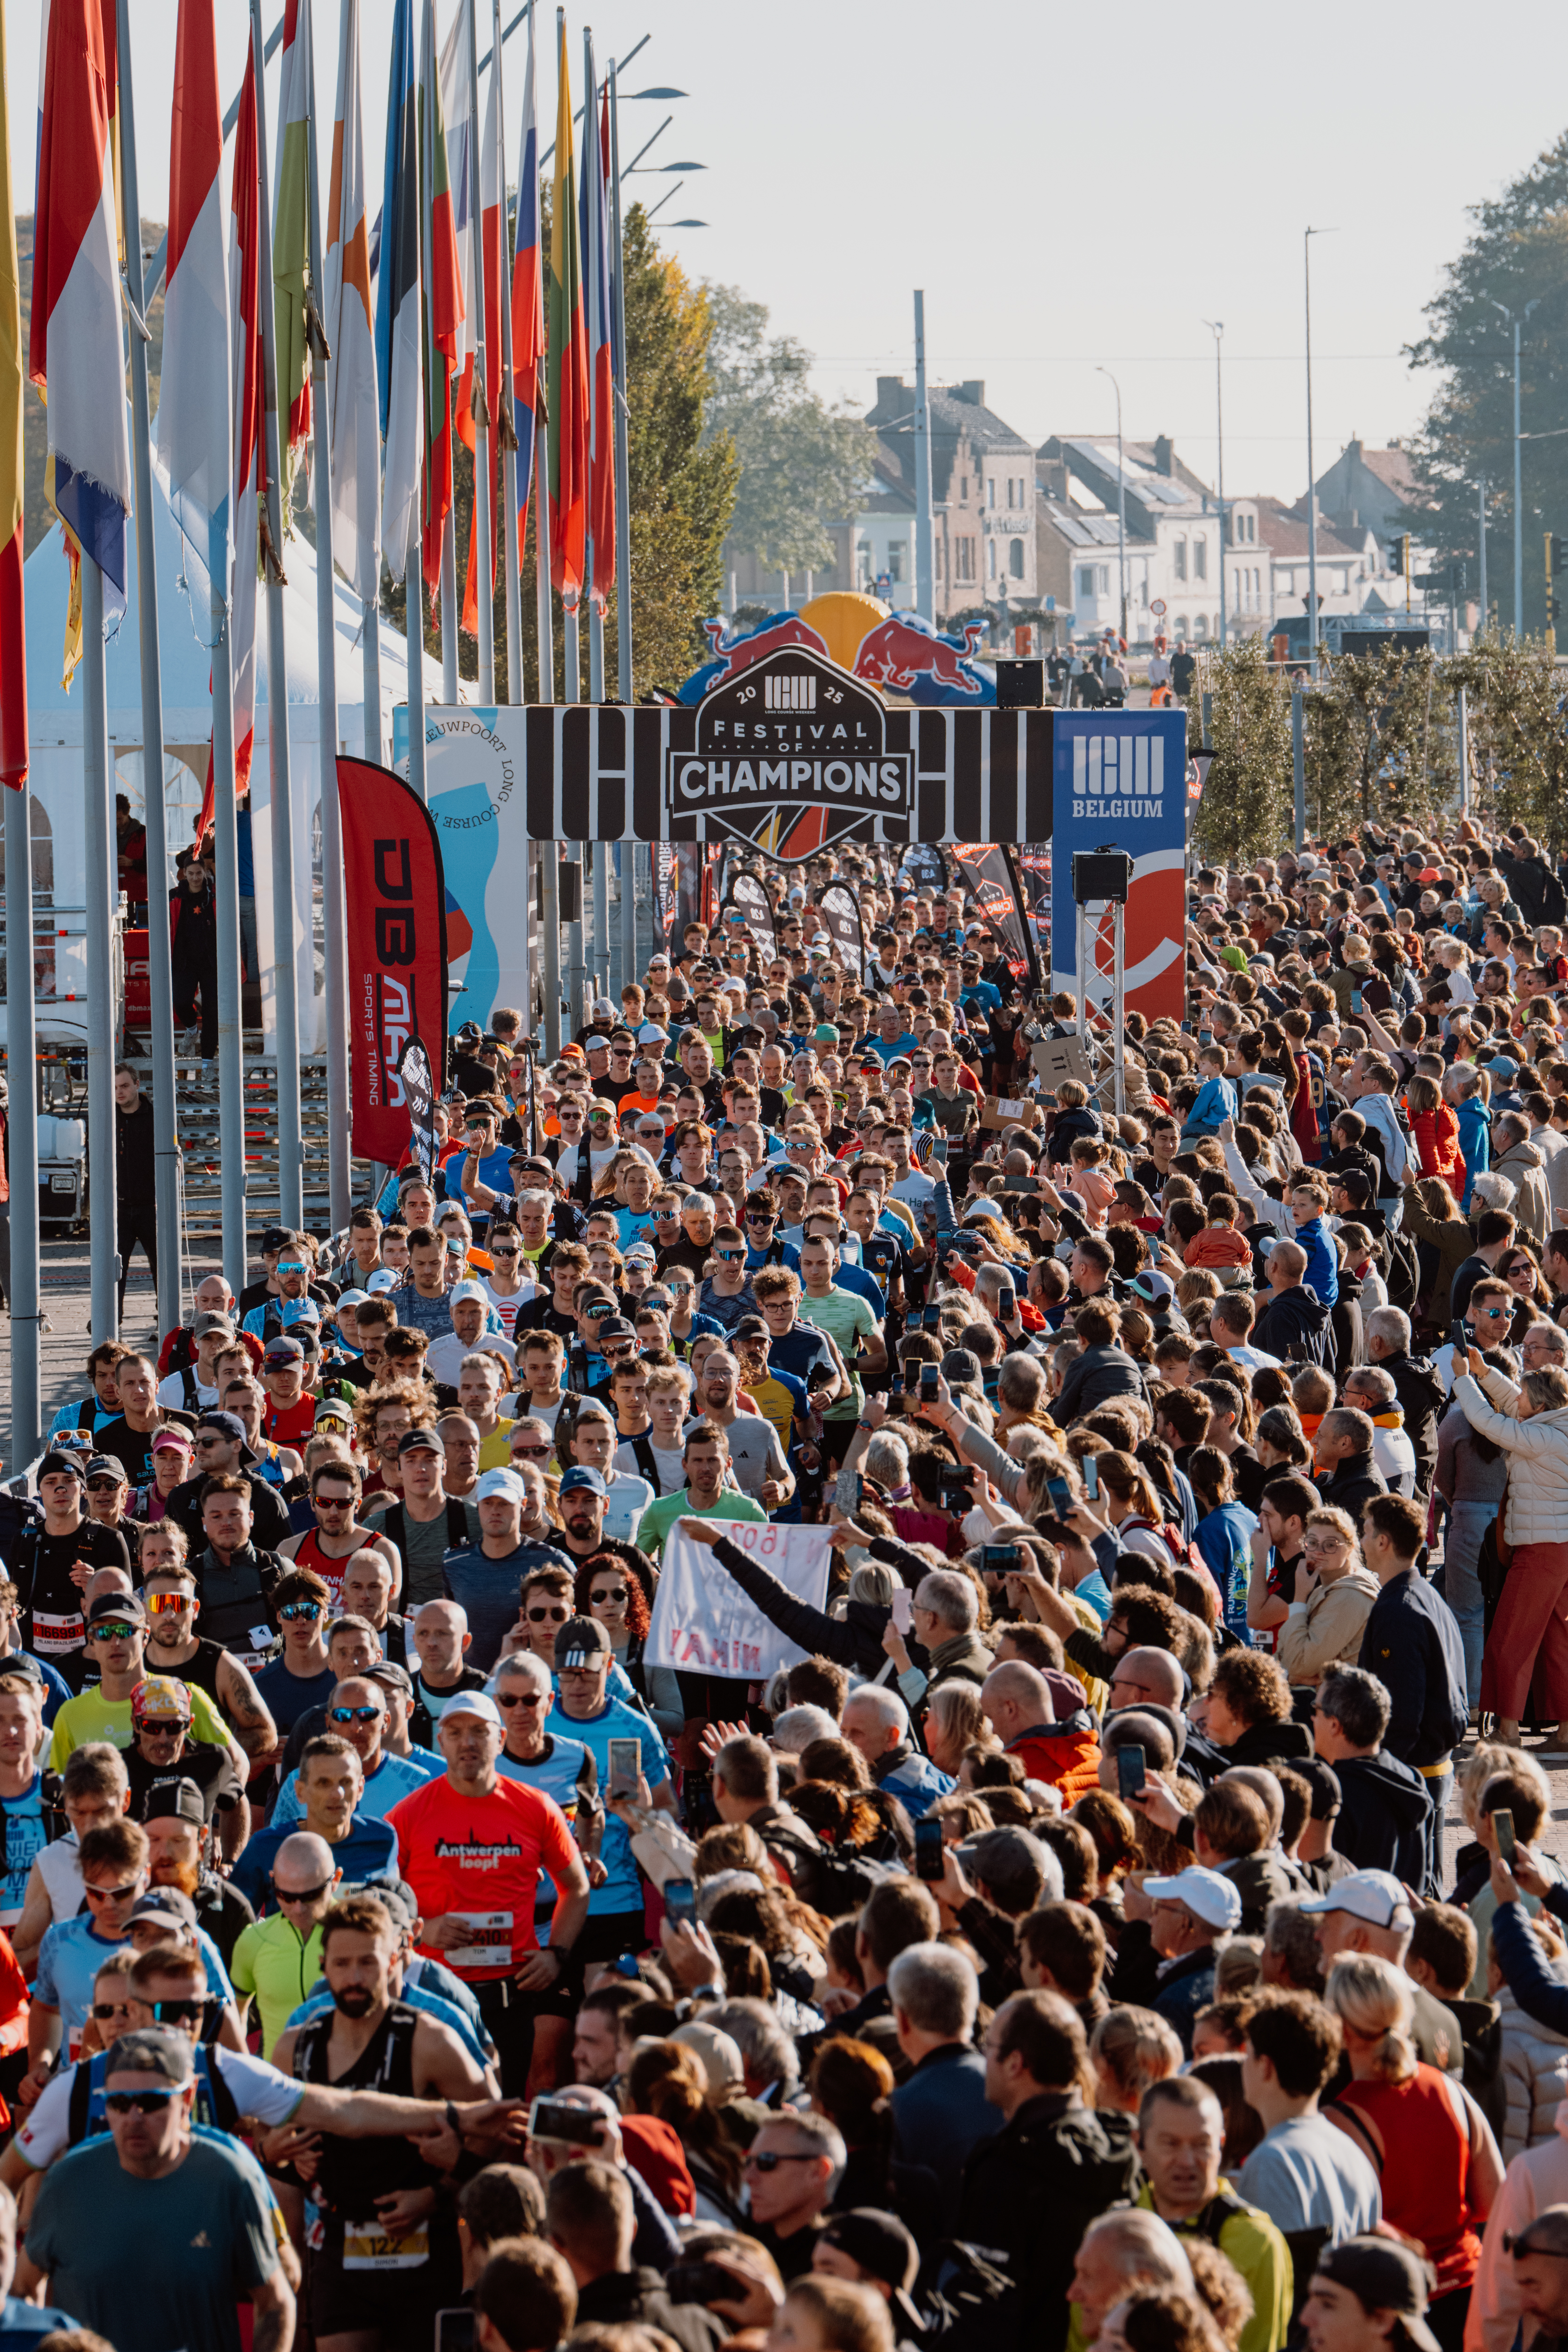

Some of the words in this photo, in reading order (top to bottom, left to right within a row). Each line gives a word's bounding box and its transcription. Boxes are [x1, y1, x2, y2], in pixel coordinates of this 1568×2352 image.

[736, 686, 756, 705] 20
[823, 687, 844, 705] 25
[426, 721, 507, 753] EUWPOORT
[714, 720, 867, 738] FESTIVAL
[778, 742, 803, 752] OF
[501, 759, 514, 803] LONG
[680, 760, 900, 801] CHAMPIONS
[443, 804, 500, 828] COURSE
[1073, 800, 1163, 818] BELGIUM
[364, 973, 375, 1041] SPORTS
[368, 1049, 379, 1106] TIMING
[1309, 1077, 1323, 1109] 19
[1228, 1565, 1238, 1615] RUNNING
[40, 1626, 76, 1639] 16699
[438, 1844, 520, 1858] Antwerpen
[460, 1854, 499, 1872] loopt
